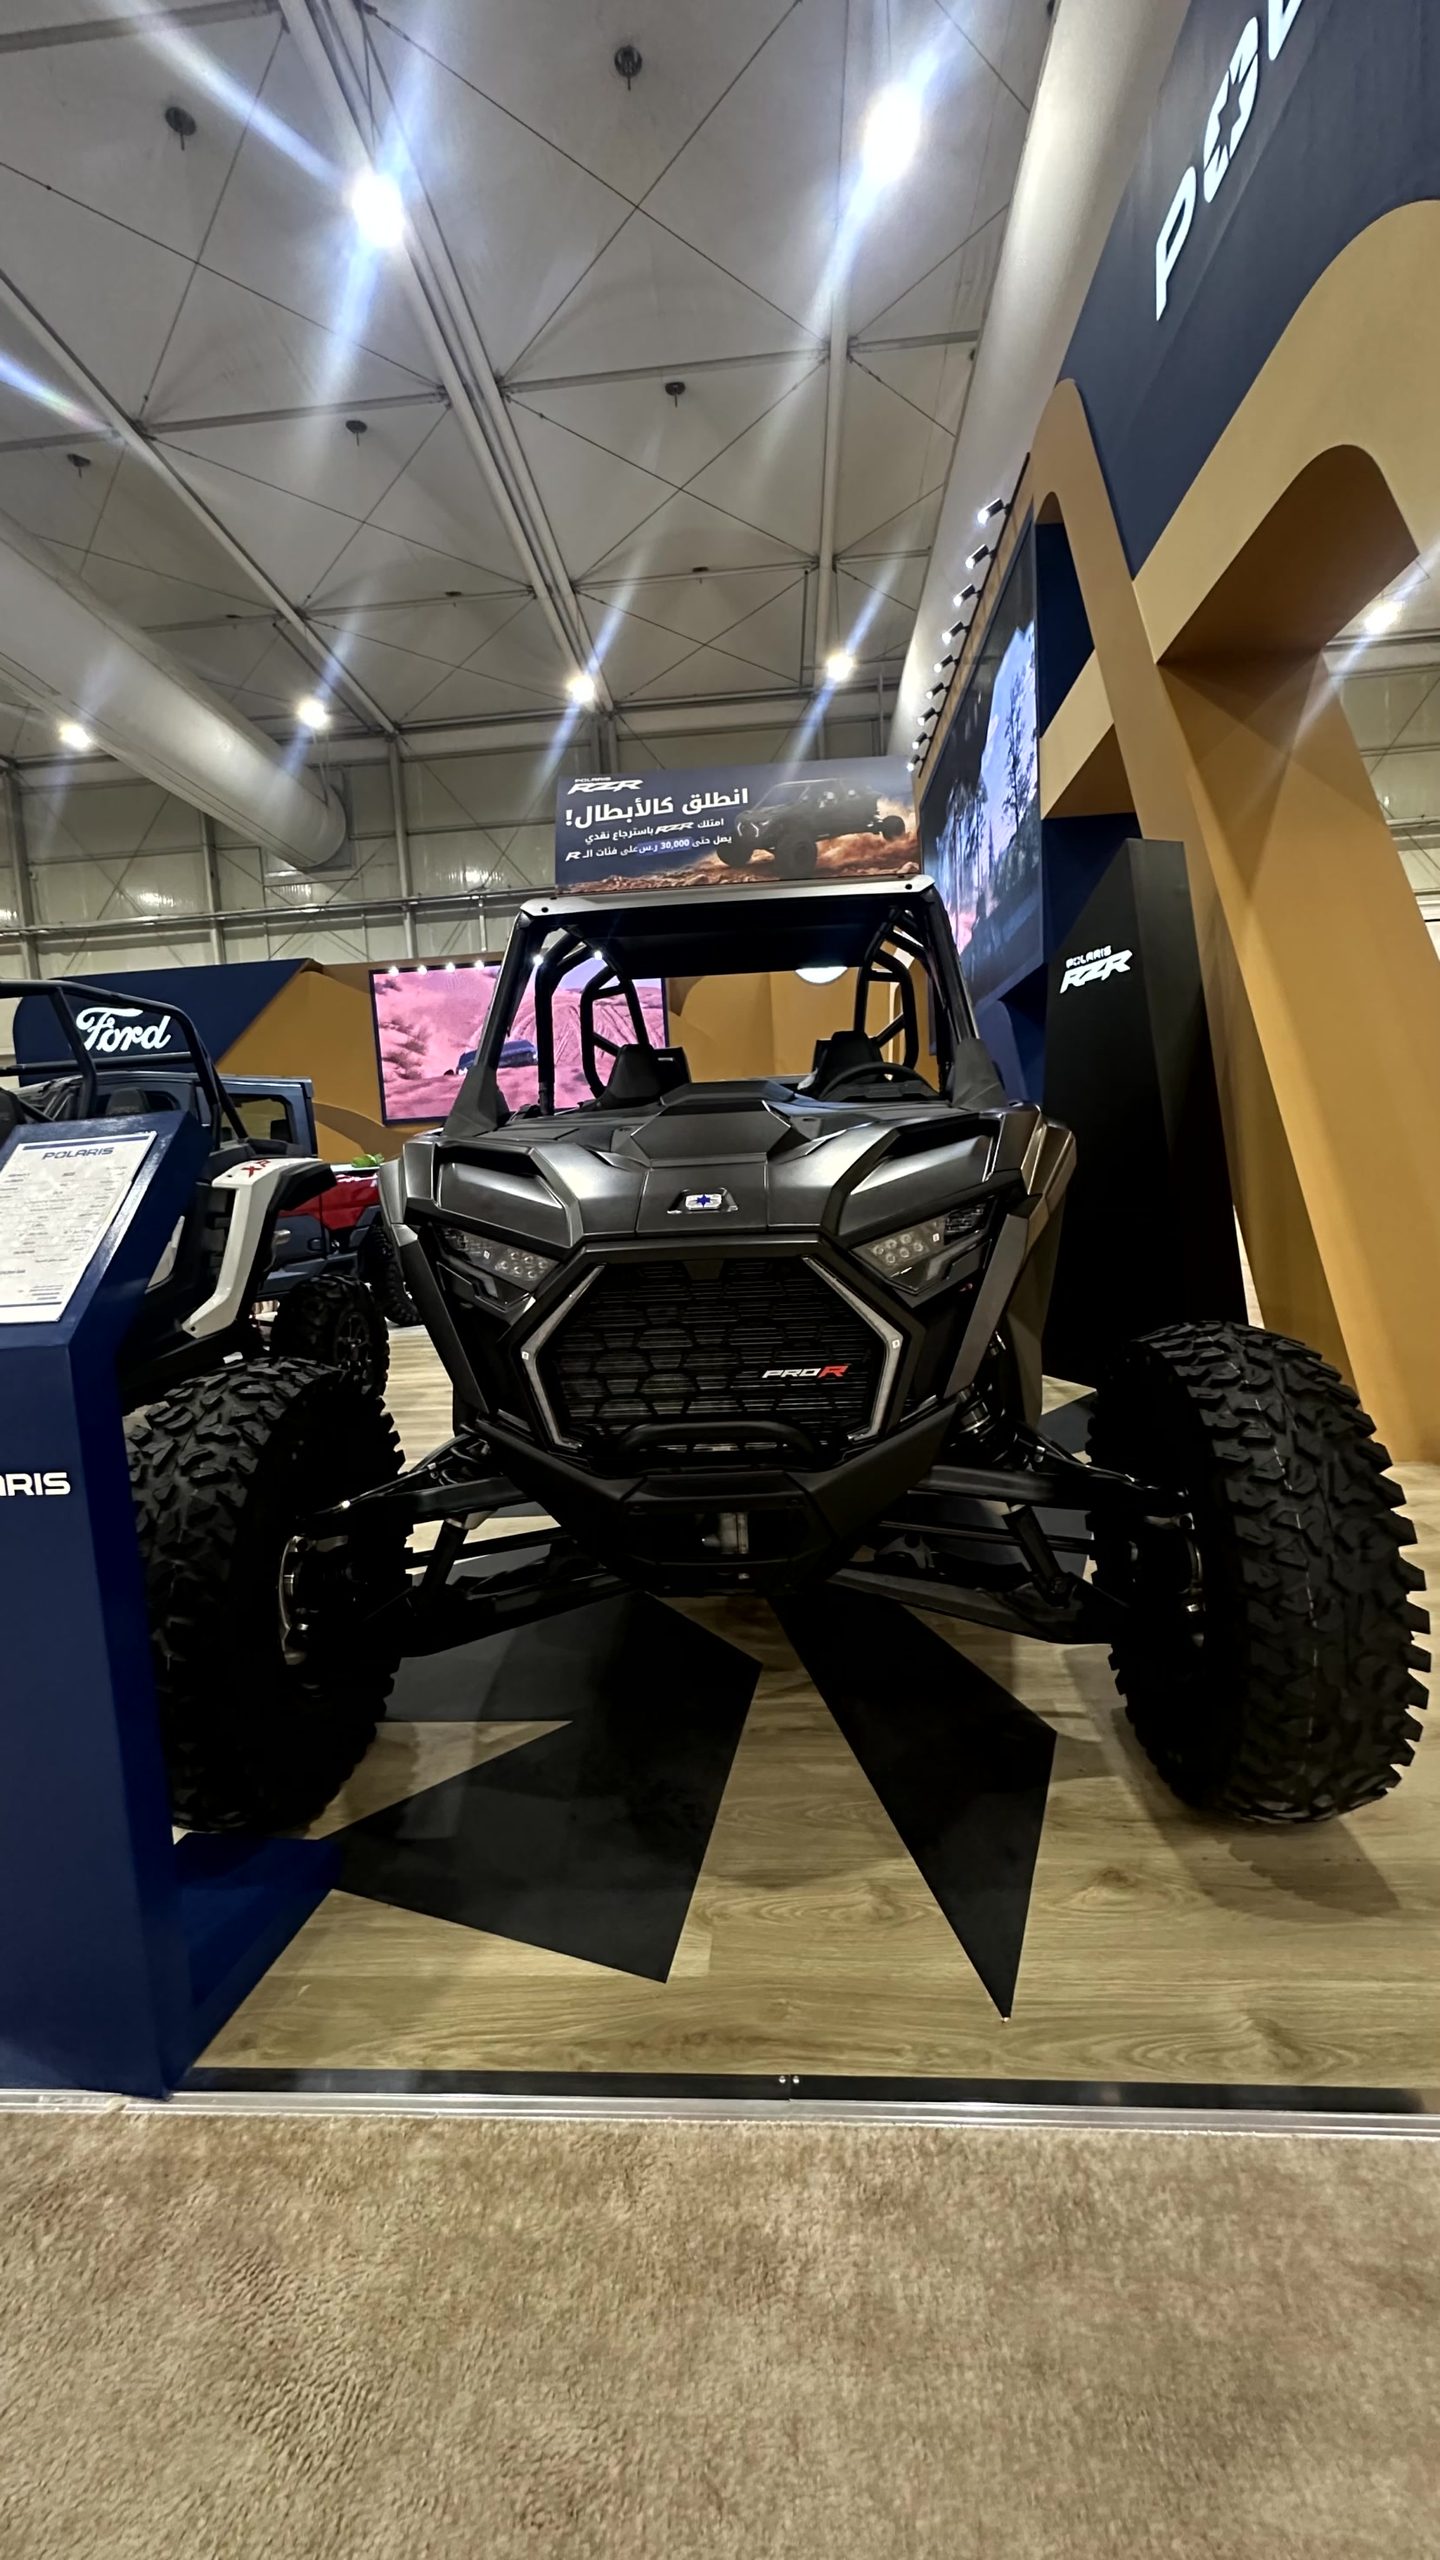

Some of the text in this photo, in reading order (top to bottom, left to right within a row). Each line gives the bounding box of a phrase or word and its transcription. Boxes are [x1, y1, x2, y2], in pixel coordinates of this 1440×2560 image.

[567, 779, 644, 795] RZR
[565, 787, 749, 829] انطلق كالأبطال!
[584, 818, 725, 845] امتلك RZR باسترجاع نقدي
[660, 838, 690, 850] 30,000
[691, 839, 711, 848] حتى
[713, 836, 732, 846] يصل
[564, 851, 582, 862] R
[595, 847, 617, 857] فئات
[620, 847, 638, 857] على
[1065, 945, 1112, 968] POLARIS
[1059, 949, 1133, 994] RZR
[76, 1007, 172, 1053] Ford
[42, 1147, 114, 1160] POLARIS
[0, 1472, 71, 1497] RIS
